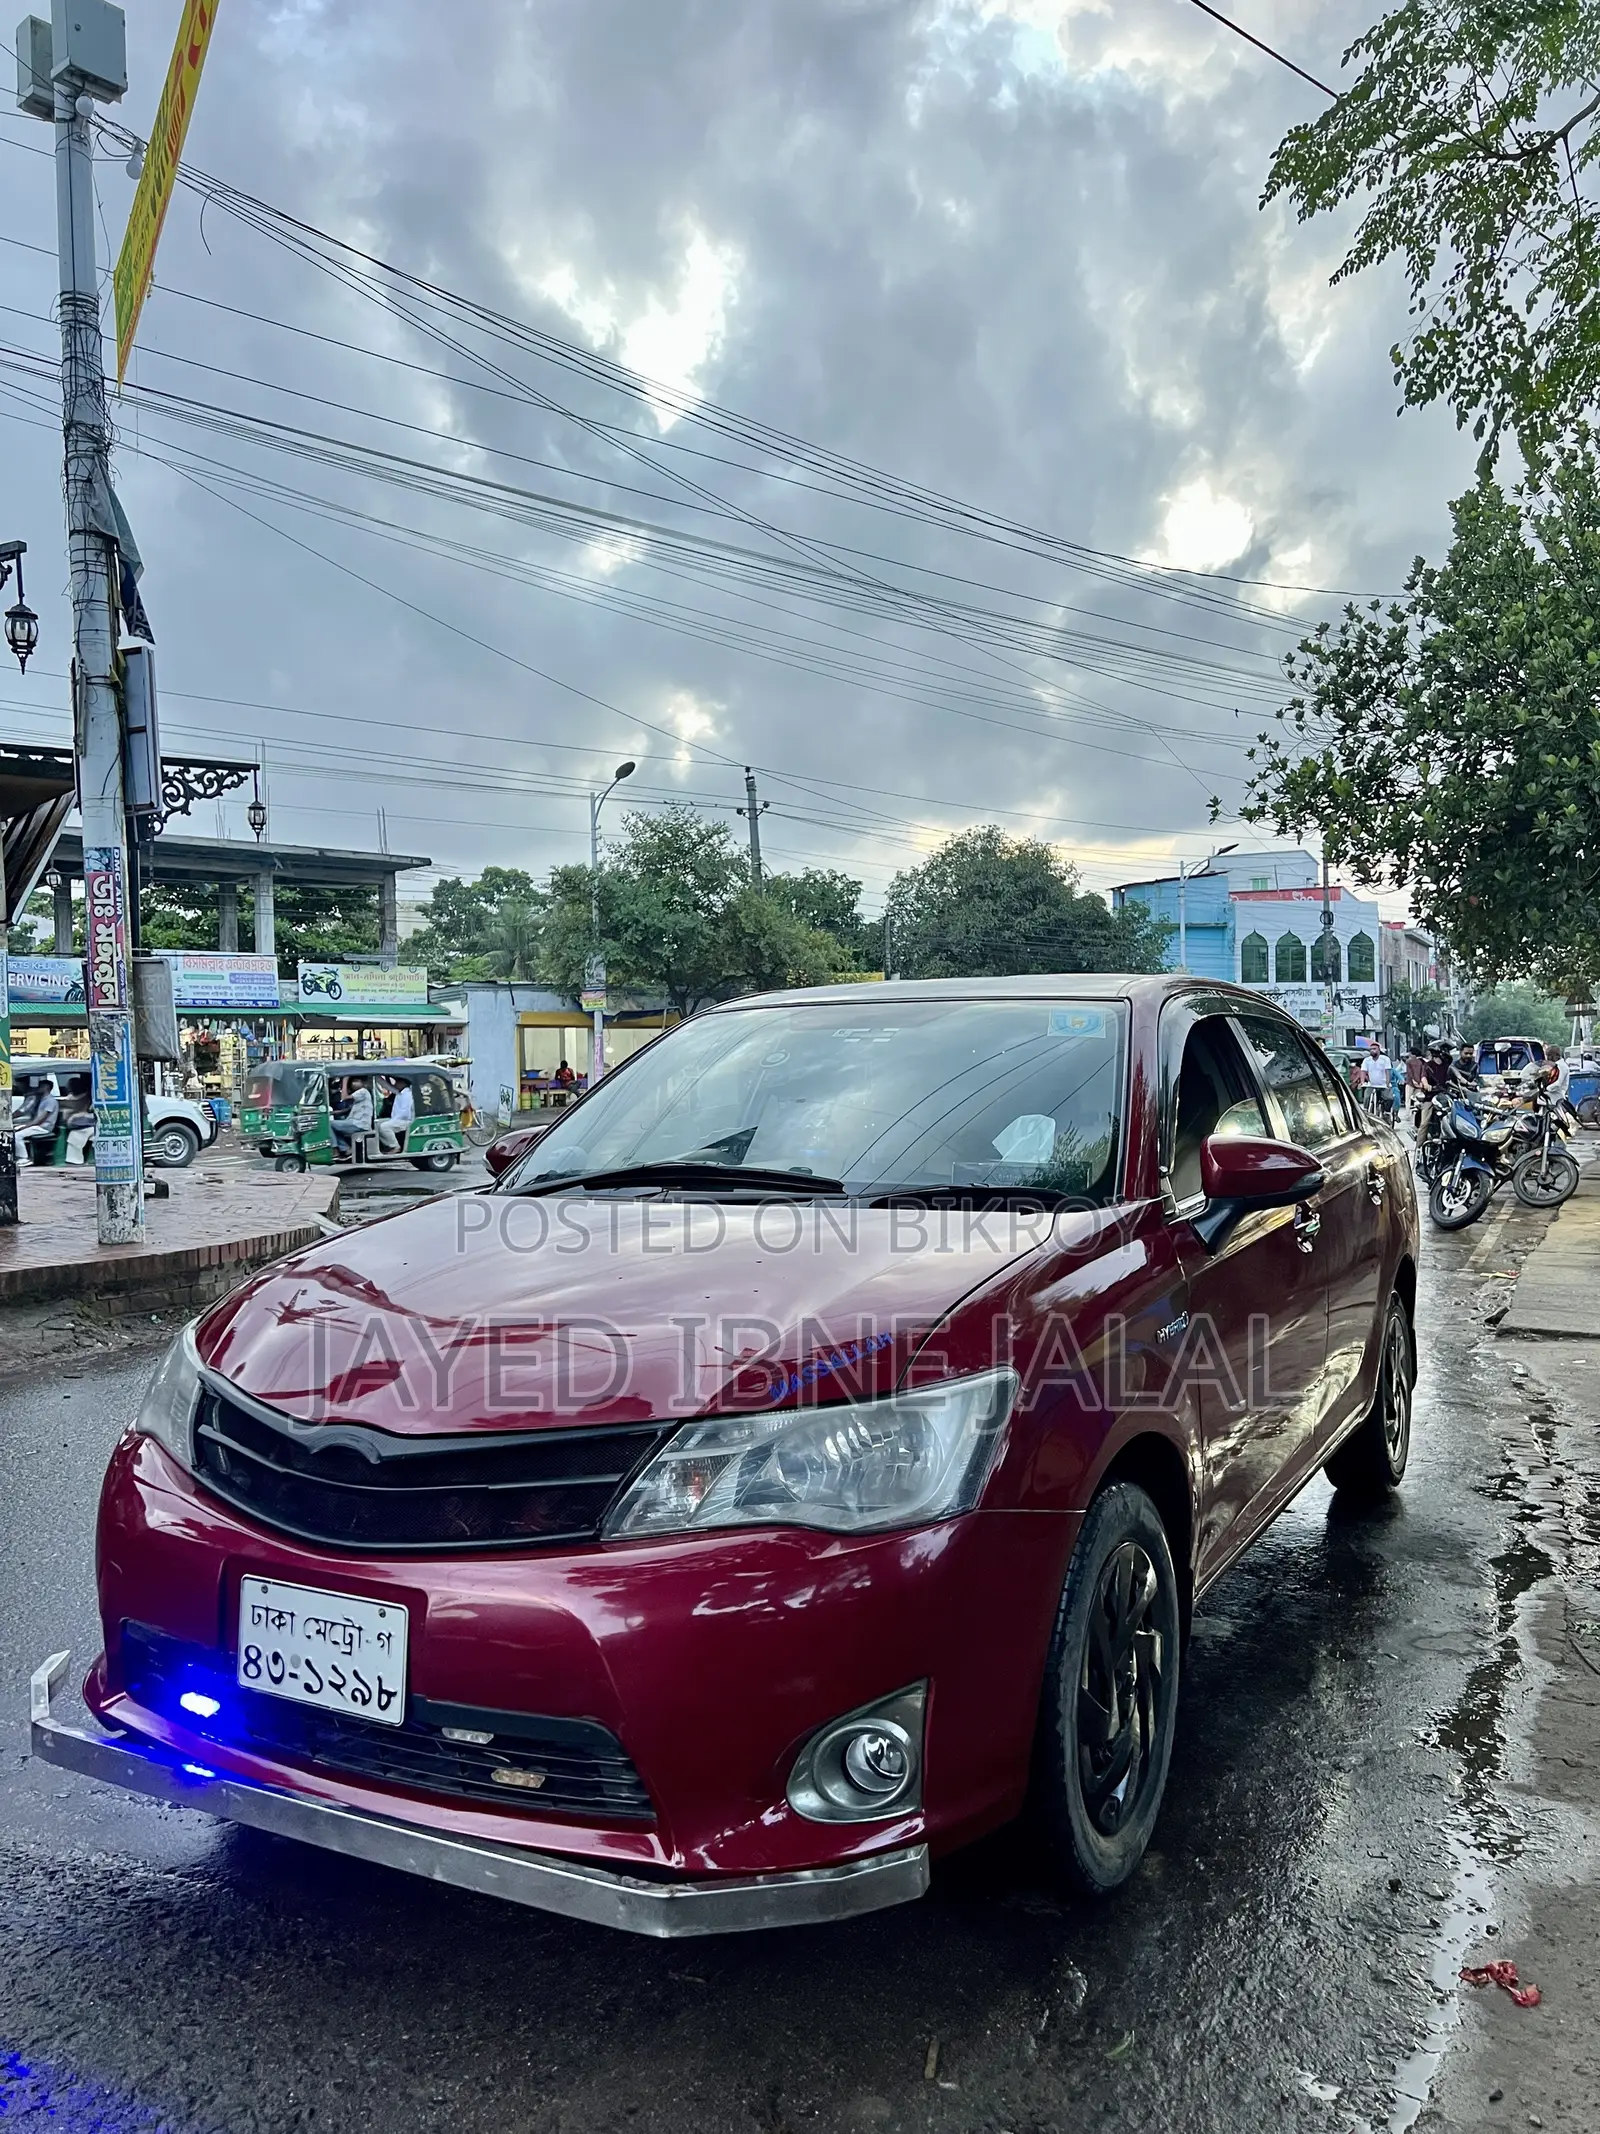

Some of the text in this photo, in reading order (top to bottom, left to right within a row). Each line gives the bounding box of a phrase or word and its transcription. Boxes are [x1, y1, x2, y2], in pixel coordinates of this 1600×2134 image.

[93, 874, 115, 918] ডাঃ
[113, 848, 123, 915] DMC AIM
[8, 973, 70, 987] ERVICING
[251, 1604, 296, 1636] ঢাকা
[242, 1644, 398, 1711] ৪৩-১২৯৮
